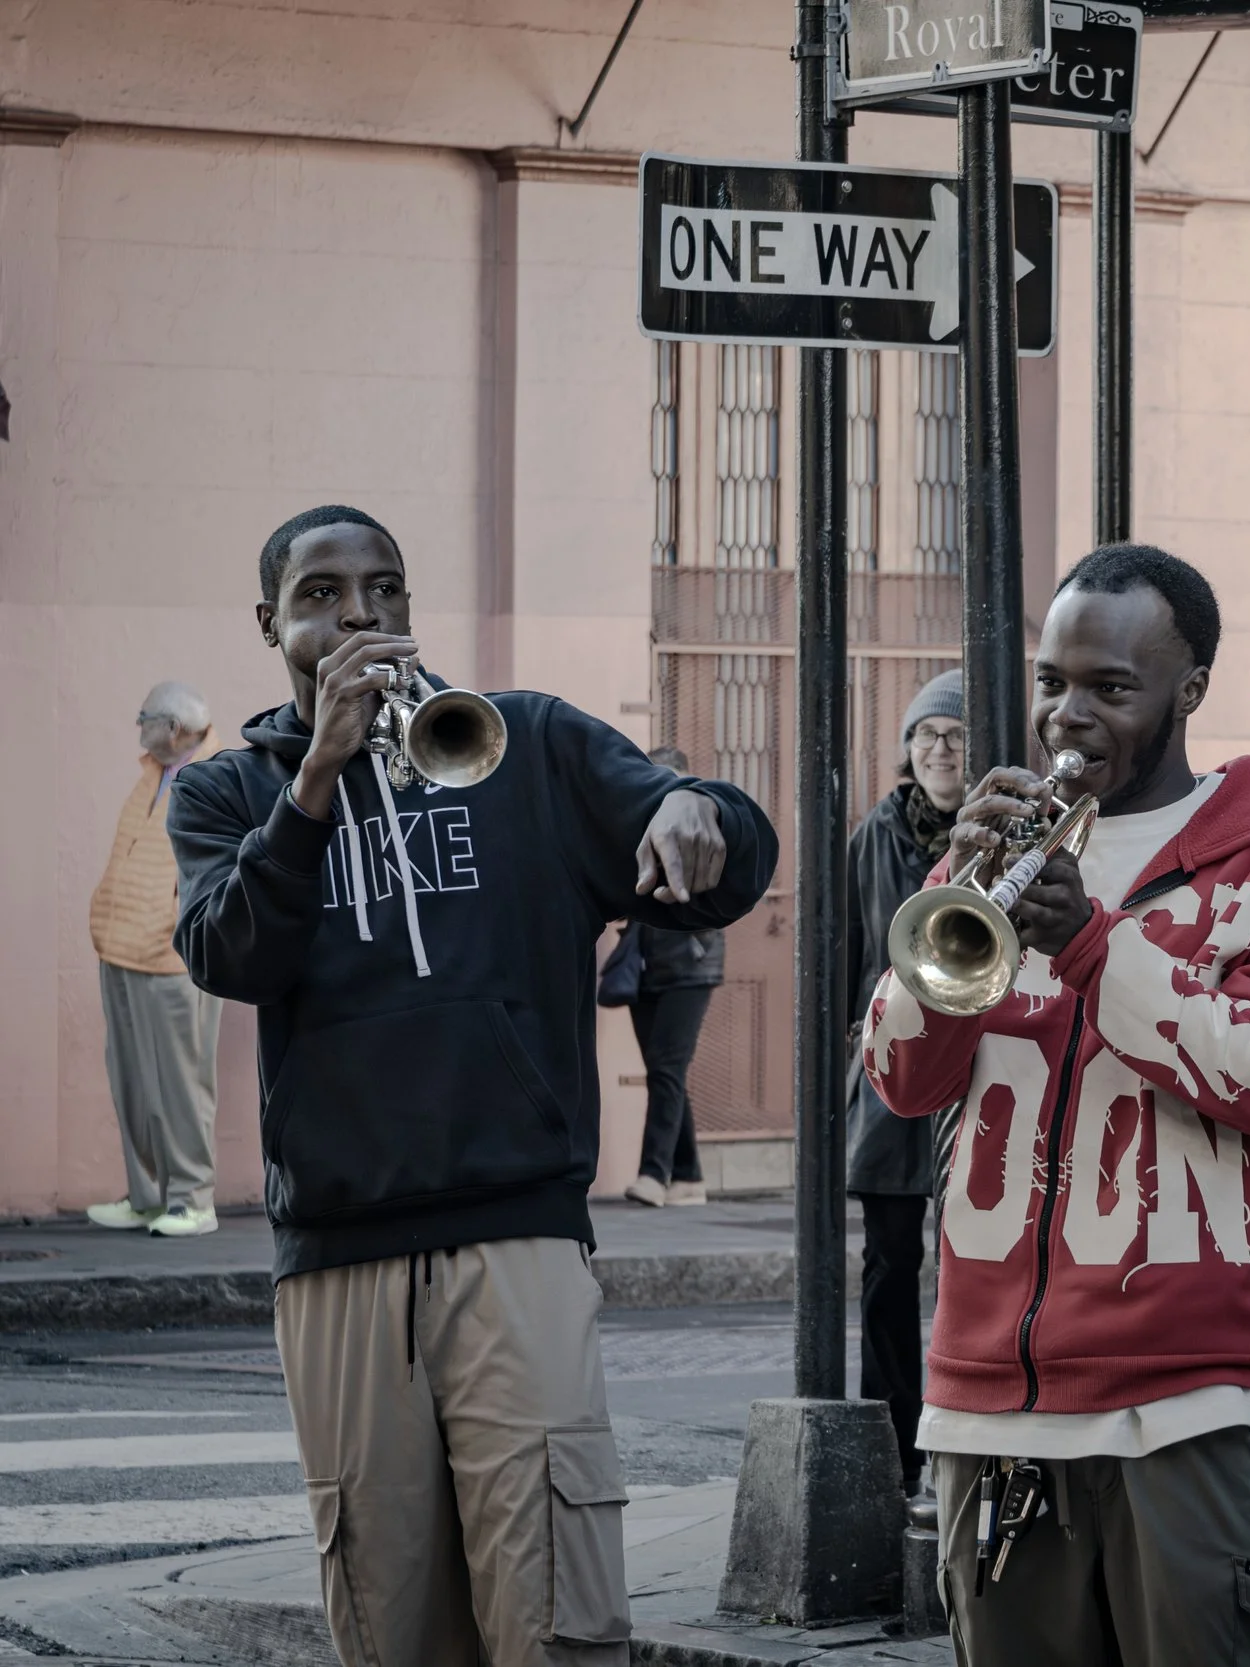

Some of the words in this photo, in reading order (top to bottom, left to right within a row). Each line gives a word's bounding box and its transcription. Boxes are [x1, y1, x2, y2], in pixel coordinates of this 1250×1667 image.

[884, 0, 1003, 65] Royal
[670, 215, 785, 284] ONE
[814, 223, 930, 291] WAY
[323, 806, 480, 908] IKE
